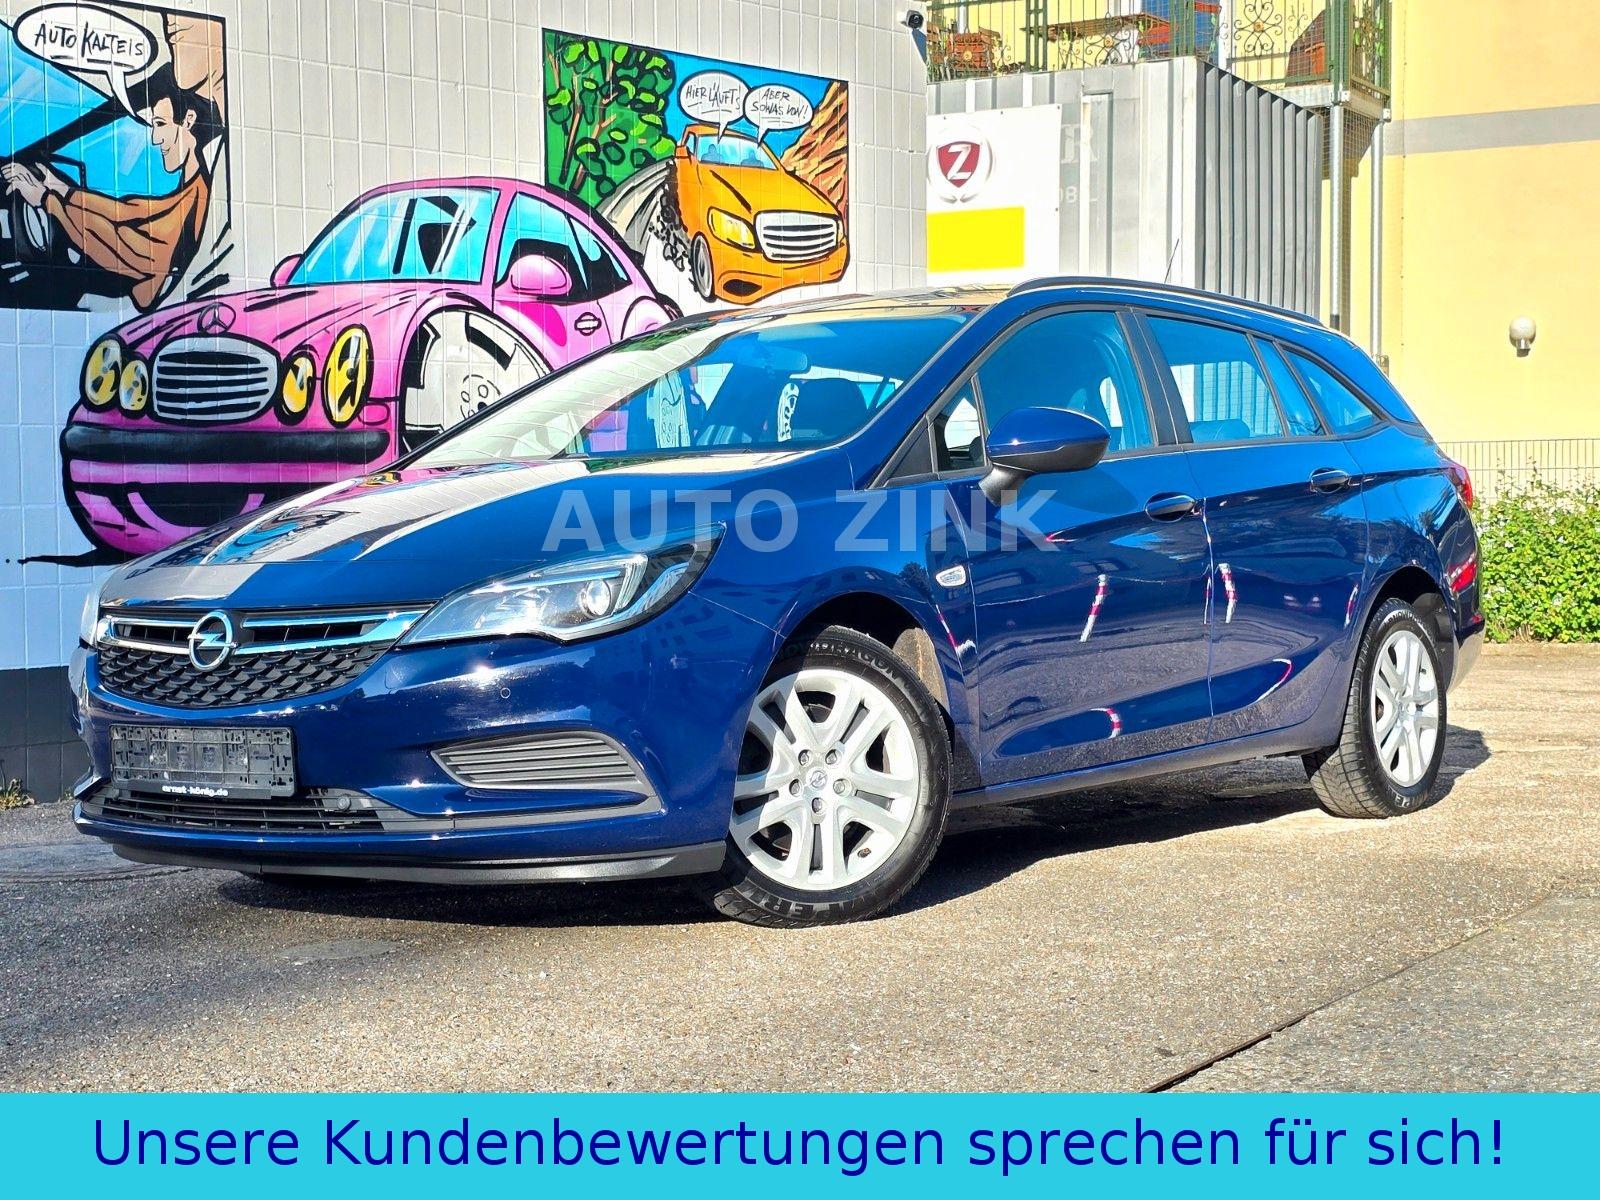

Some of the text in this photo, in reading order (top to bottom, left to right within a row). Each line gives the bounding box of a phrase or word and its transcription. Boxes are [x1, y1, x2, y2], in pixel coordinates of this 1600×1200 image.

[81, 21, 144, 57] KALTEIS
[686, 84, 707, 99] HIER
[761, 88, 790, 102] ABER
[750, 100, 784, 116] SOWAS
